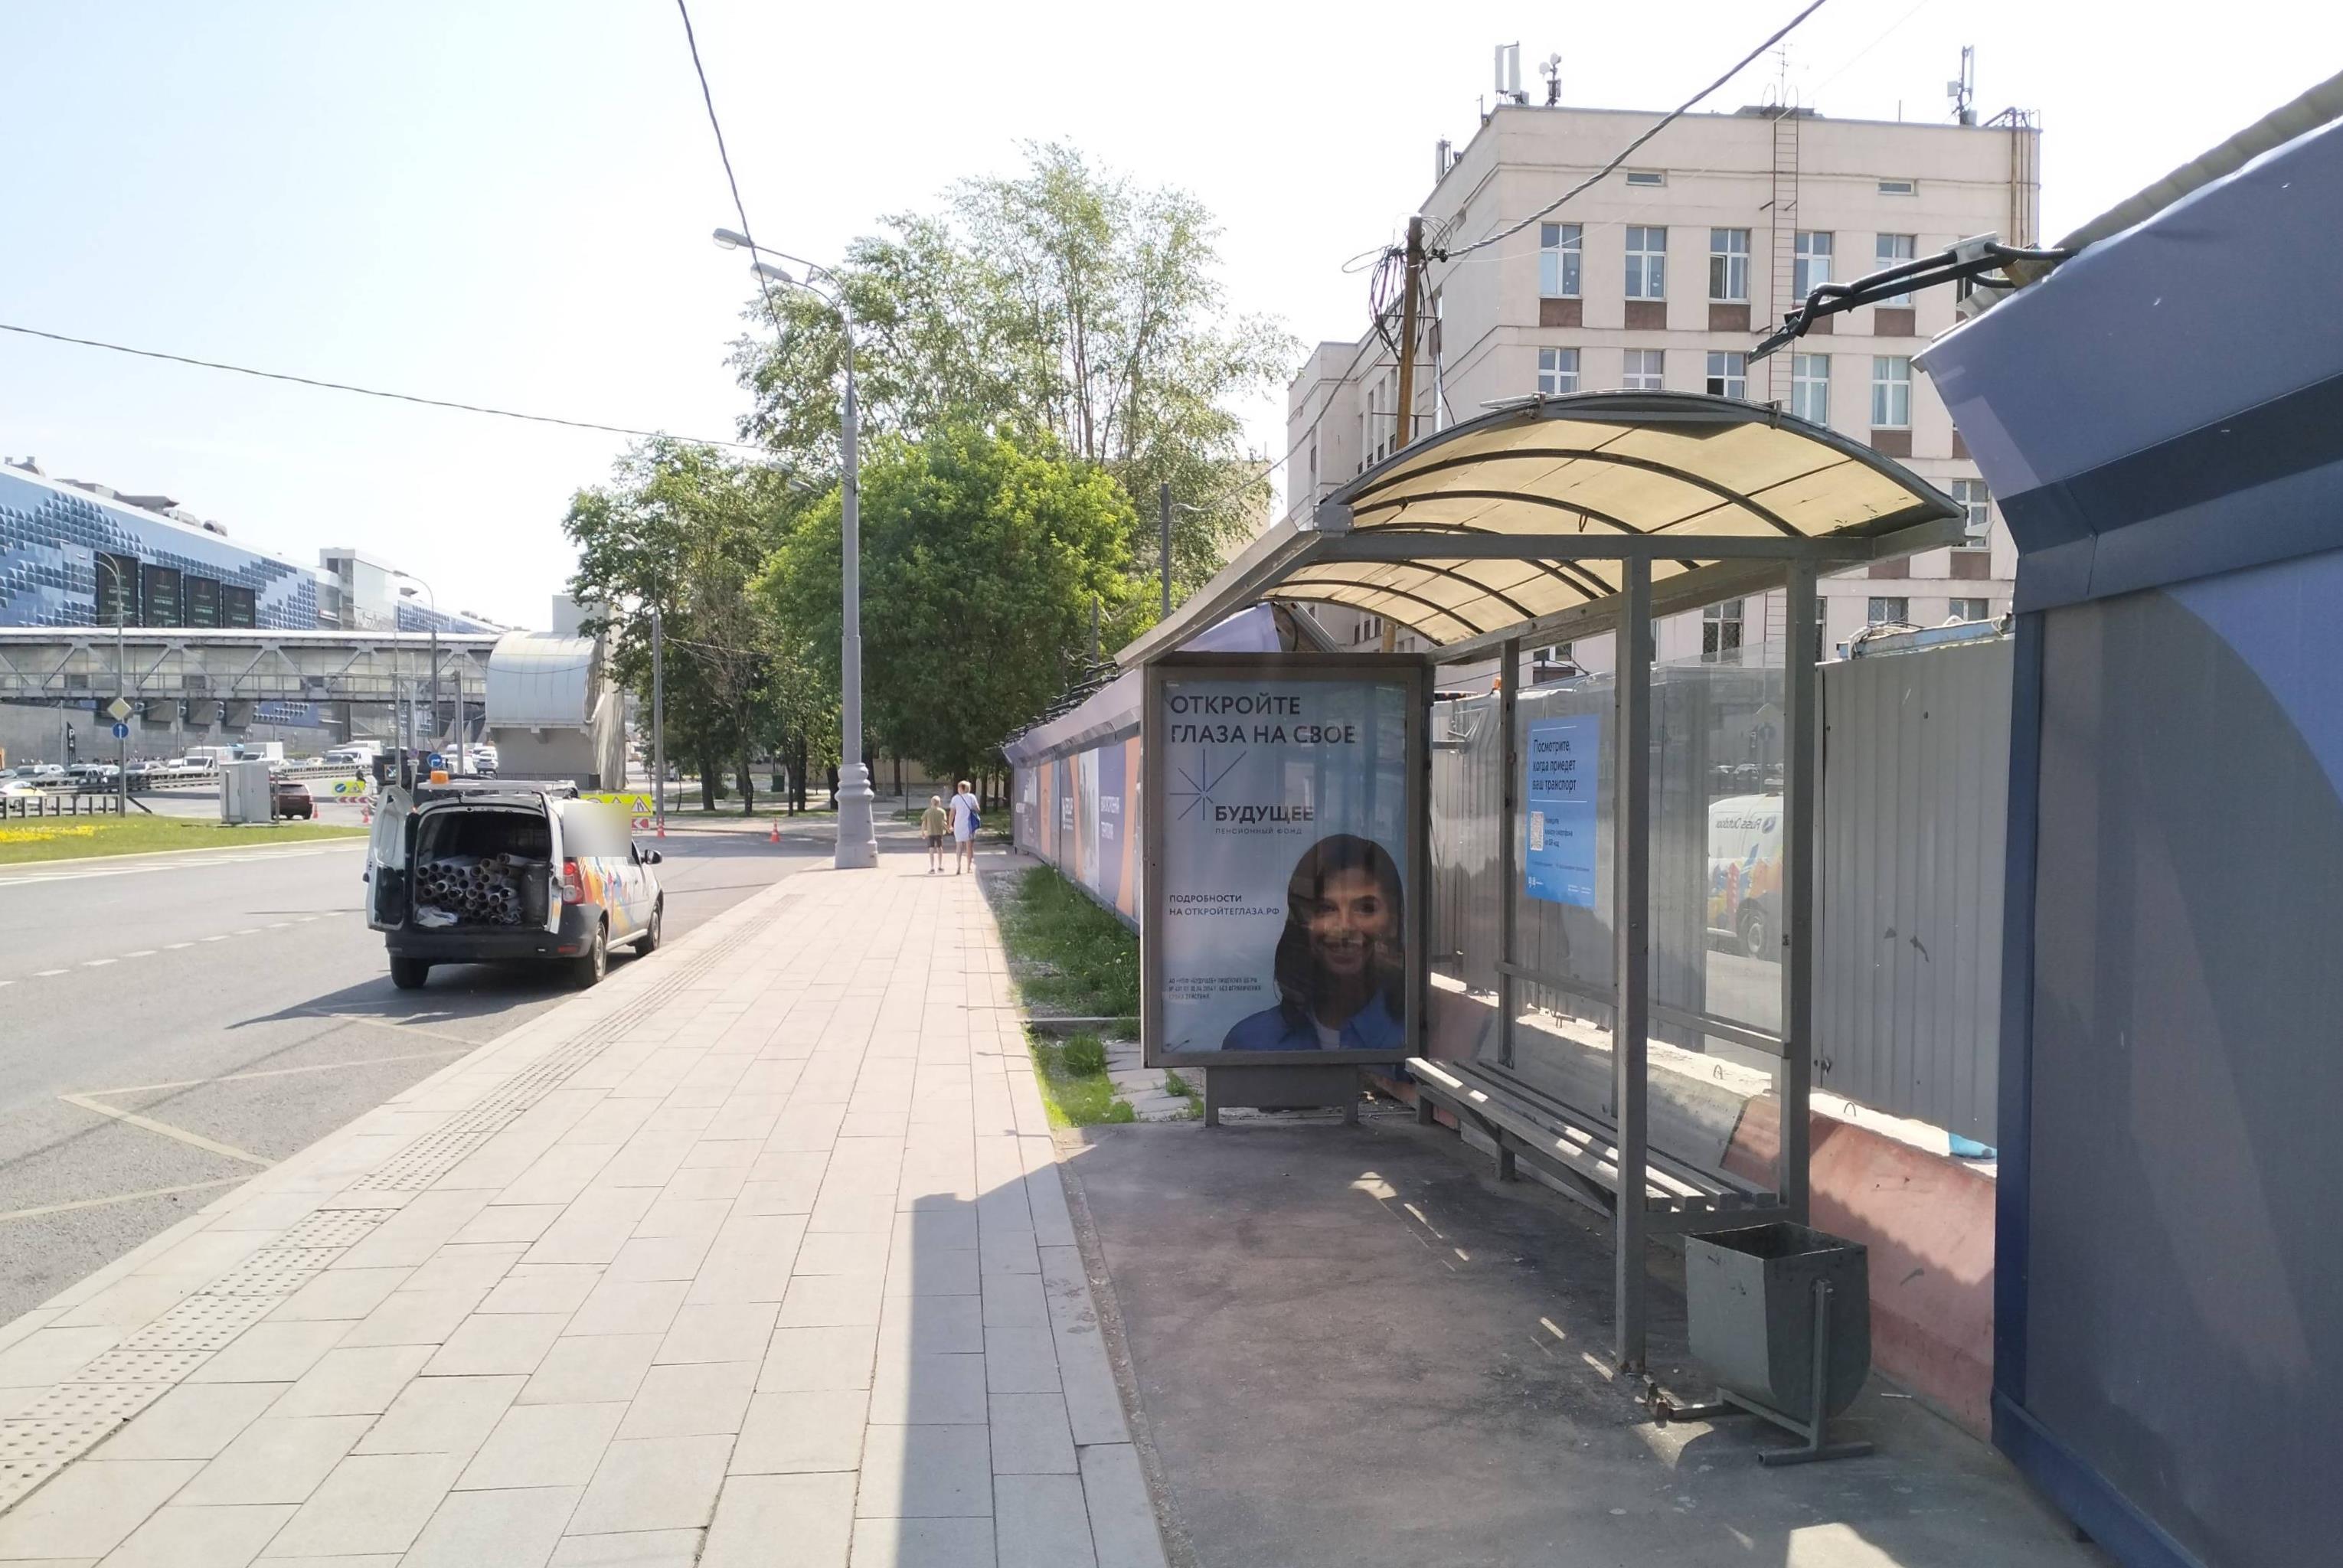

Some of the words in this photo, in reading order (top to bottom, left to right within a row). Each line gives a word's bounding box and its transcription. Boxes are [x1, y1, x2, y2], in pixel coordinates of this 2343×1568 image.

[1170, 692, 1301, 715] ОТКРОЙТЕ
[1171, 724, 1247, 743] ГЛАЗА
[1253, 725, 1287, 743] НА
[1293, 725, 1356, 744] СВОЕ
[1534, 739, 1571, 754] Посмотрите,
[1532, 760, 1549, 773] когда
[1550, 760, 1576, 775] приедет
[1532, 779, 1544, 790] ваш
[1545, 779, 1577, 794] транспорт
[1215, 805, 1314, 825] БУДУЩЕЕ
[1169, 894, 1242, 903] ПОДРОБНОСТИ
[1169, 907, 1183, 916] НА
[1185, 906, 1279, 916] ОТКРОЙТЕГЛАЗА.РФ
